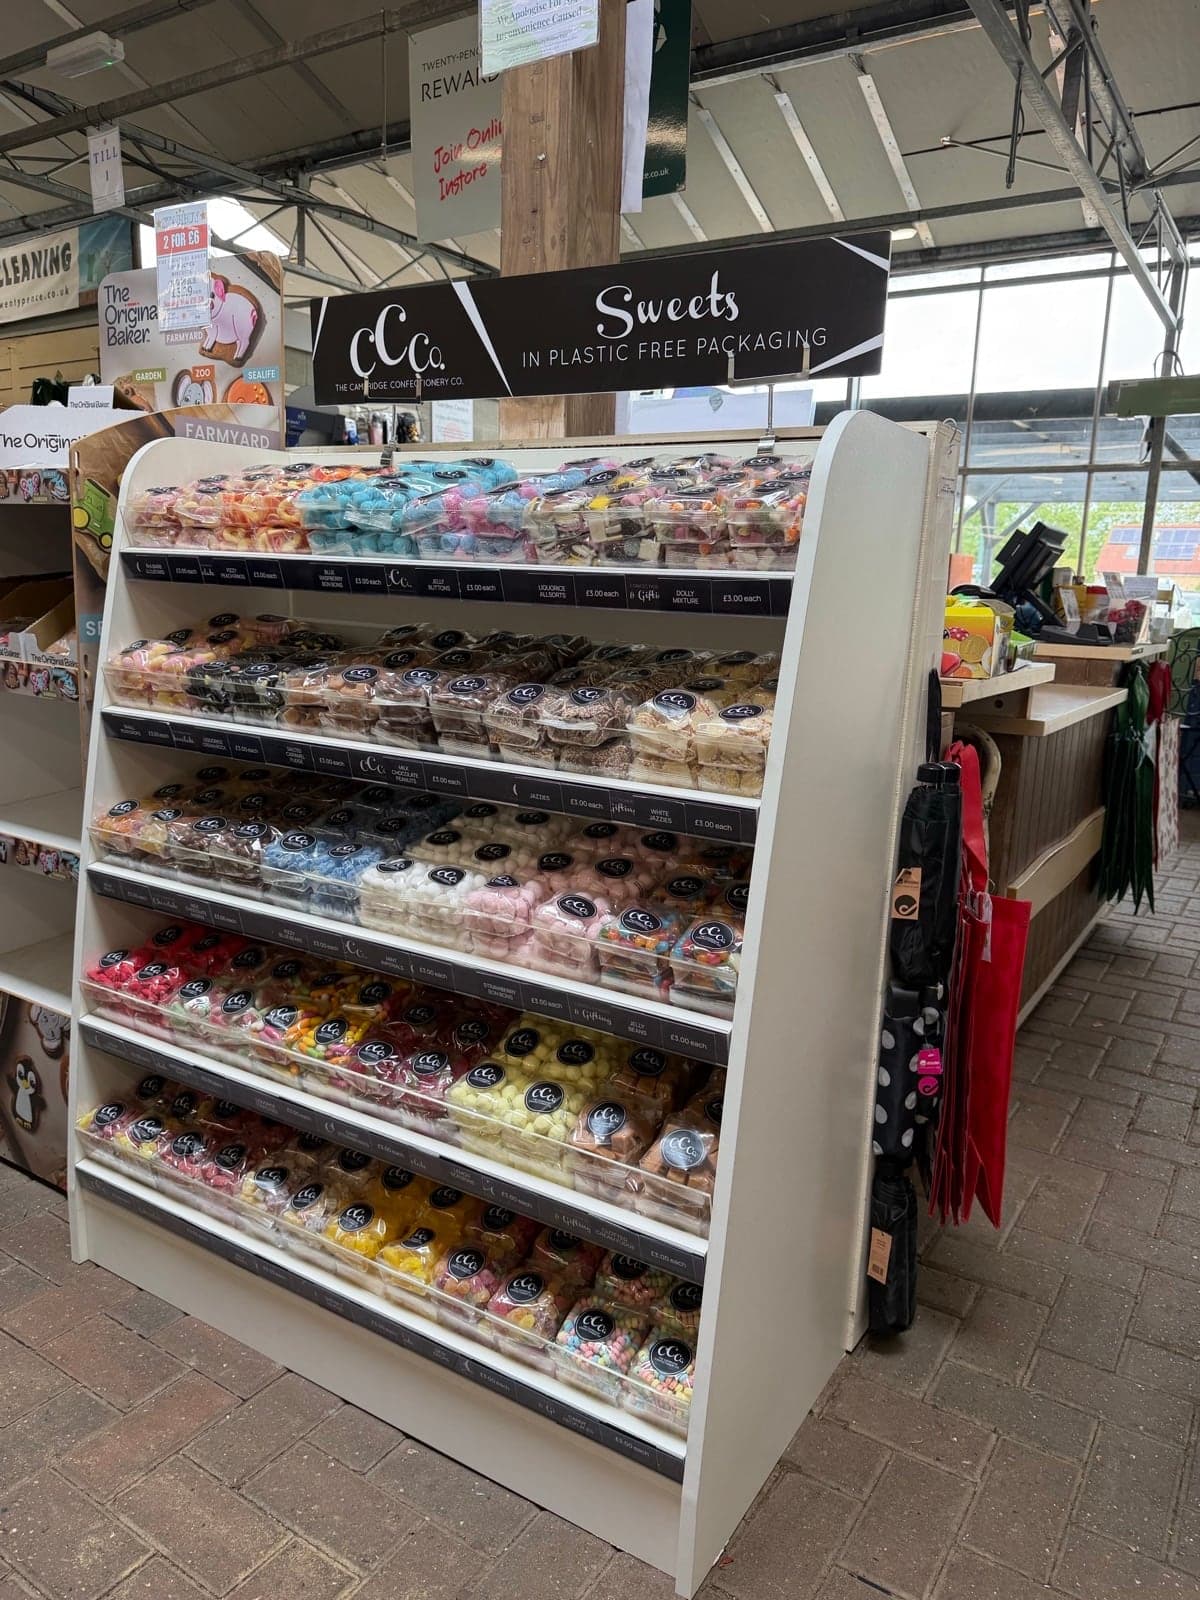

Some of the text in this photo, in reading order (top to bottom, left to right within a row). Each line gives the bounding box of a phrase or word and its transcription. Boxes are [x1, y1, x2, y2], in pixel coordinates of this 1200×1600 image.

[552, 5, 582, 25] Caused
[92, 150, 119, 164] TILL
[434, 142, 463, 175] Join
[439, 161, 487, 201] Instore
[163, 229, 200, 249] 2 FOR £6
[104, 285, 130, 302] The
[596, 270, 740, 339] Sweets
[166, 332, 204, 343] FARMYARD
[522, 327, 828, 368] IN PLASTIC FREE PACKAGING
[135, 371, 162, 381] GARDEN
[194, 368, 211, 378] ZOO
[247, 369, 276, 380] SEALIFE
[336, 376, 464, 393] THE CAMRIDGE CONFECIONERY CO.
[185, 423, 270, 449] FARMYARD
[586, 589, 619, 598] £3.00 each
[676, 589, 694, 597] DOLLY
[723, 594, 762, 603] £3.00 each
[672, 597, 700, 605] MIXTURE
[432, 774, 448, 784] £3.00
[569, 798, 604, 810] £3.00 each
[650, 808, 669, 817] WHITE
[694, 819, 733, 832] £3.00 each
[531, 996, 563, 1010] £3.00 each
[628, 1025, 648, 1037] BEANS
[629, 1020, 646, 1031] JELLY
[670, 1033, 708, 1050] £3.00 each
